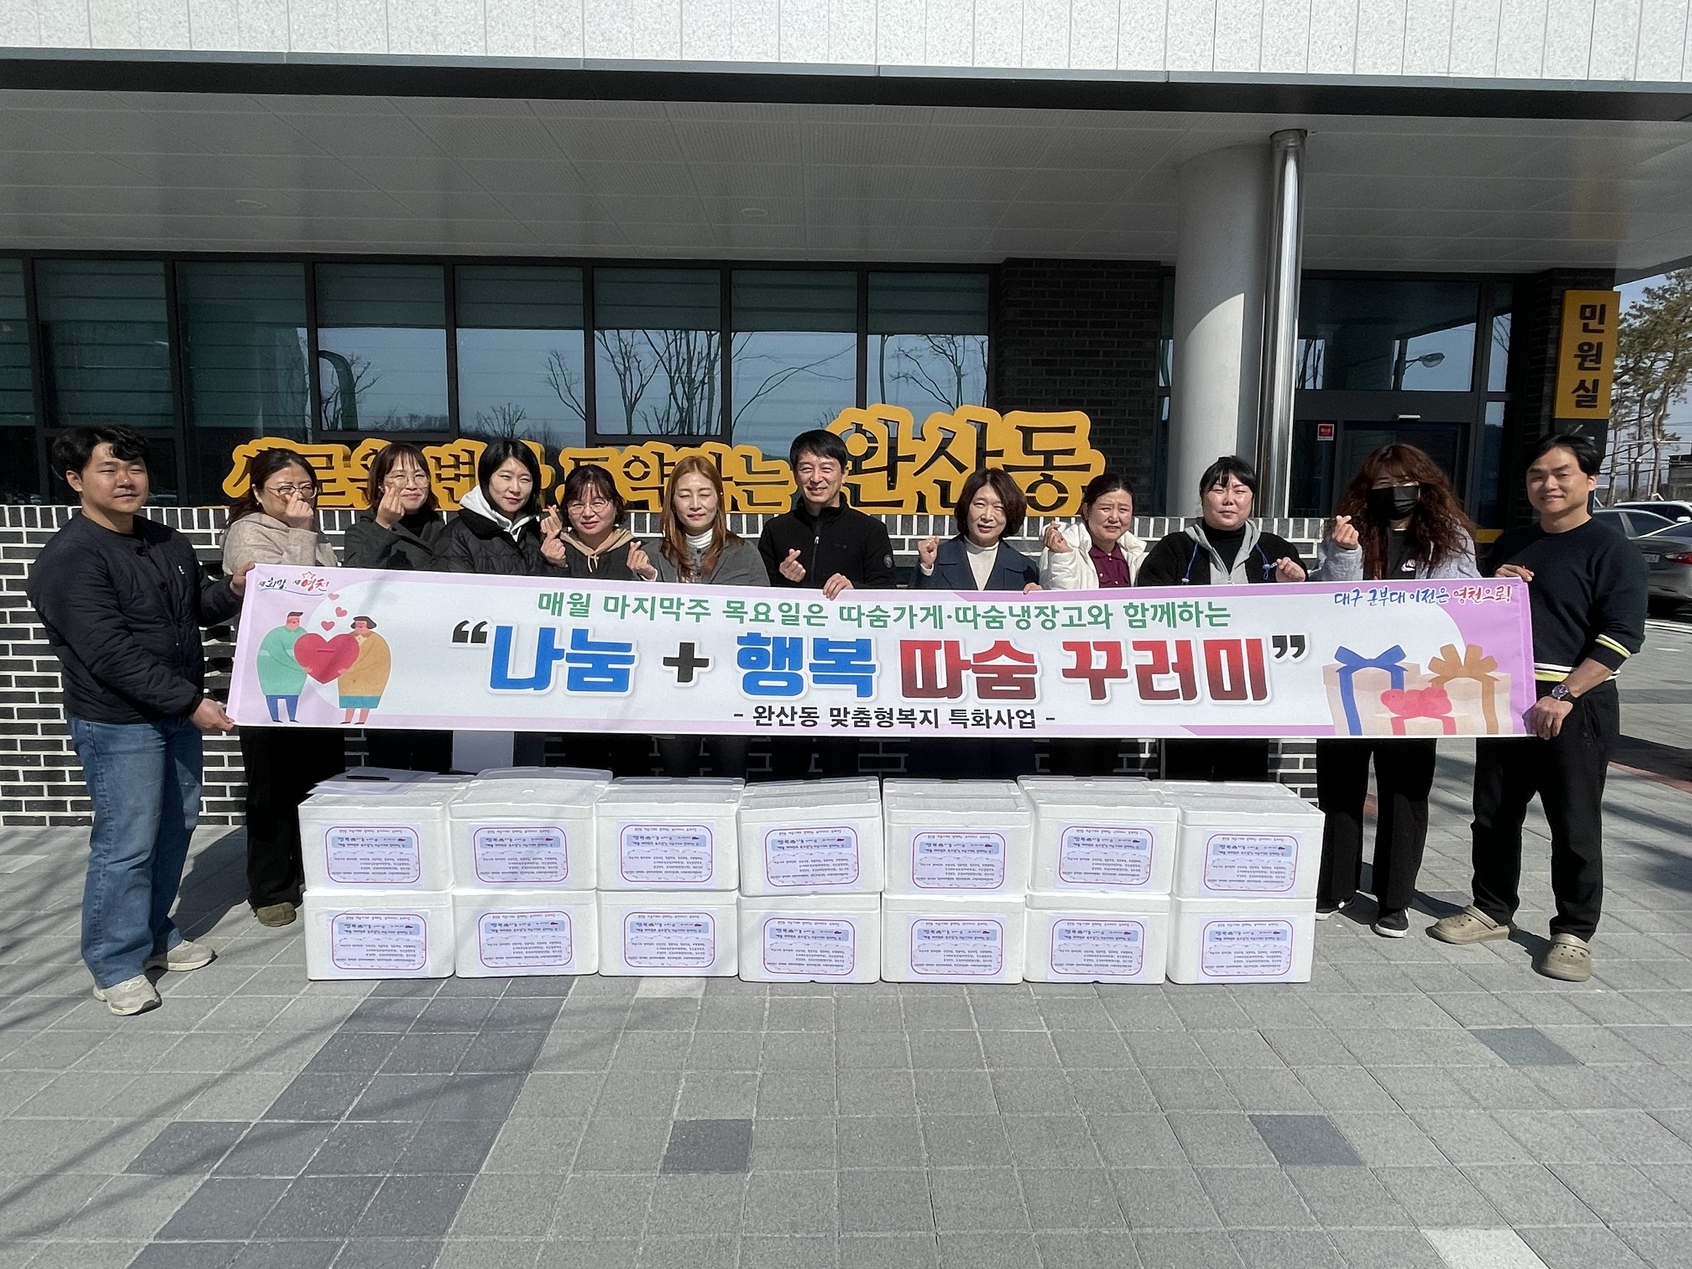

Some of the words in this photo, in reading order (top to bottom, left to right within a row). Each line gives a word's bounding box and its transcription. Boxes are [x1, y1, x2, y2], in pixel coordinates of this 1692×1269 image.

[1571, 303, 1607, 409] 민원실
[834, 414, 1095, 513] 완산동
[538, 592, 591, 618] 매월
[603, 594, 712, 624] 마지막주
[722, 600, 829, 628] 목요일은
[1123, 601, 1231, 630] 함께하는
[1334, 588, 1363, 608] 대구
[1366, 586, 1406, 607] 군부대
[1408, 587, 1450, 604] 이전은
[1453, 585, 1513, 605] 영천으로!
[736, 632, 876, 698] 행복
[899, 639, 1038, 700] 따숨
[752, 705, 820, 728] 완산동
[829, 706, 940, 730] 맞춤형복지
[948, 708, 1037, 730] 특화사업
